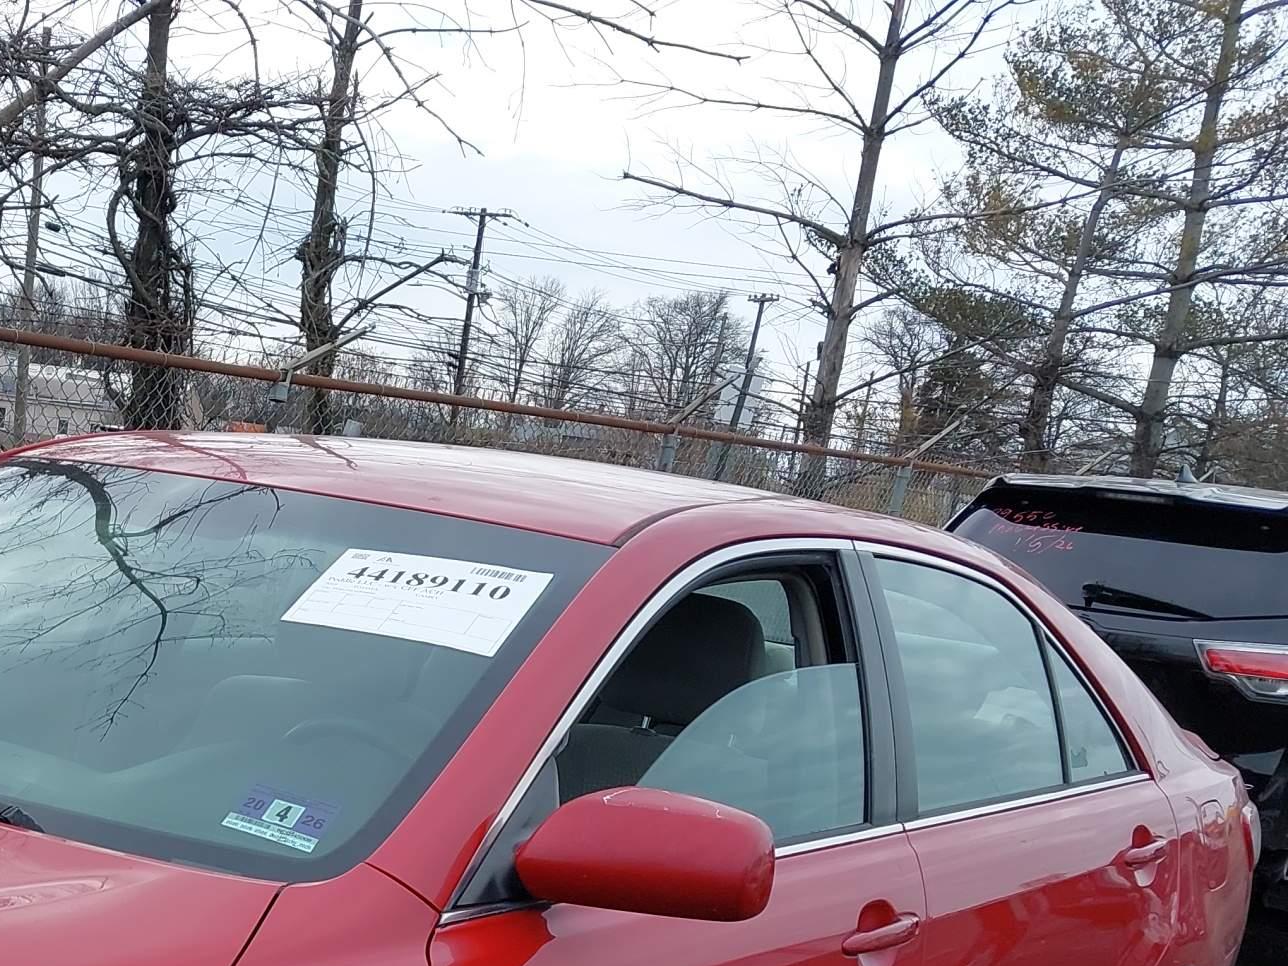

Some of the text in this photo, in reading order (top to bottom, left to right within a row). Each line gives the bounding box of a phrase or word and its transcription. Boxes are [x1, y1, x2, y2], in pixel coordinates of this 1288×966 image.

[347, 566, 511, 600] 44189110
[243, 797, 265, 811] 20
[275, 805, 293, 823] 4
[301, 815, 326, 830] 26
